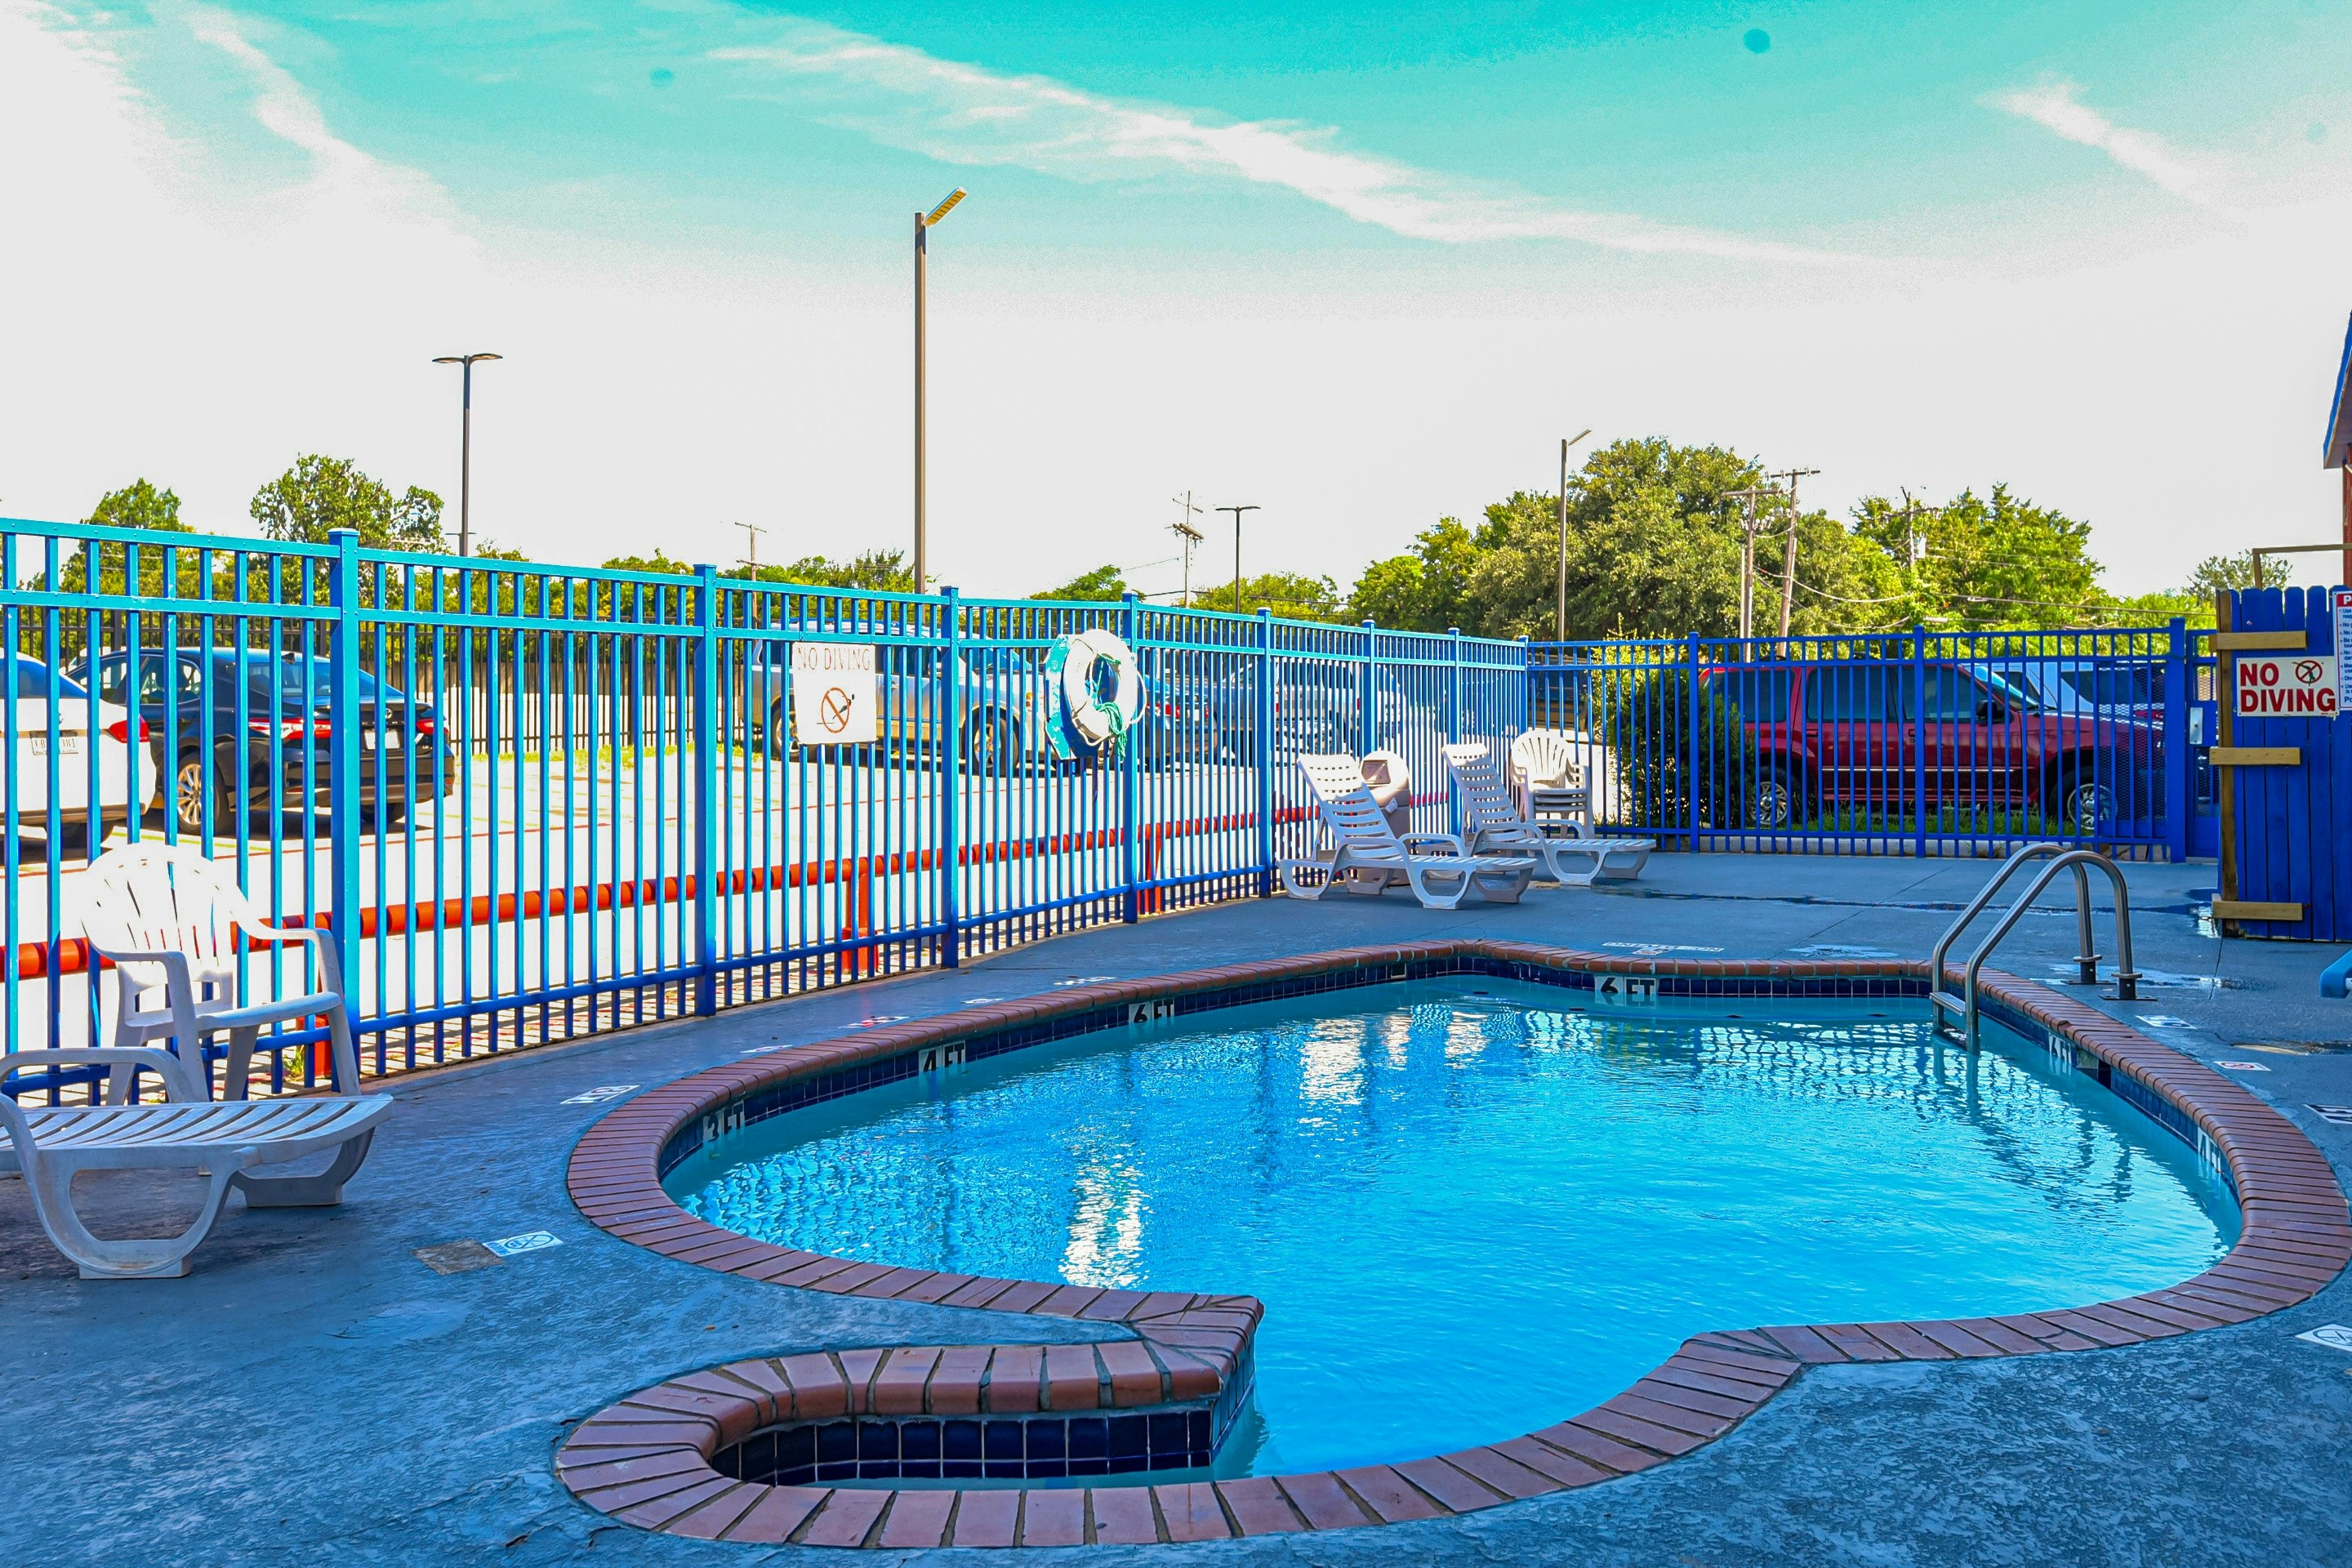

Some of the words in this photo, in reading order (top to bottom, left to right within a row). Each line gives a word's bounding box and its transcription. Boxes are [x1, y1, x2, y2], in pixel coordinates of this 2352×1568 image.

[798, 647, 817, 670] NO
[824, 648, 871, 670] DIVING
[2240, 662, 2279, 687] NO
[2240, 688, 2336, 713] DIVING
[1600, 977, 1619, 994] 6
[1626, 978, 1655, 996] FT
[1134, 1004, 1148, 1023] 6
[1153, 999, 1174, 1020] FT
[944, 1042, 965, 1068] FT
[724, 1102, 744, 1135] FT
